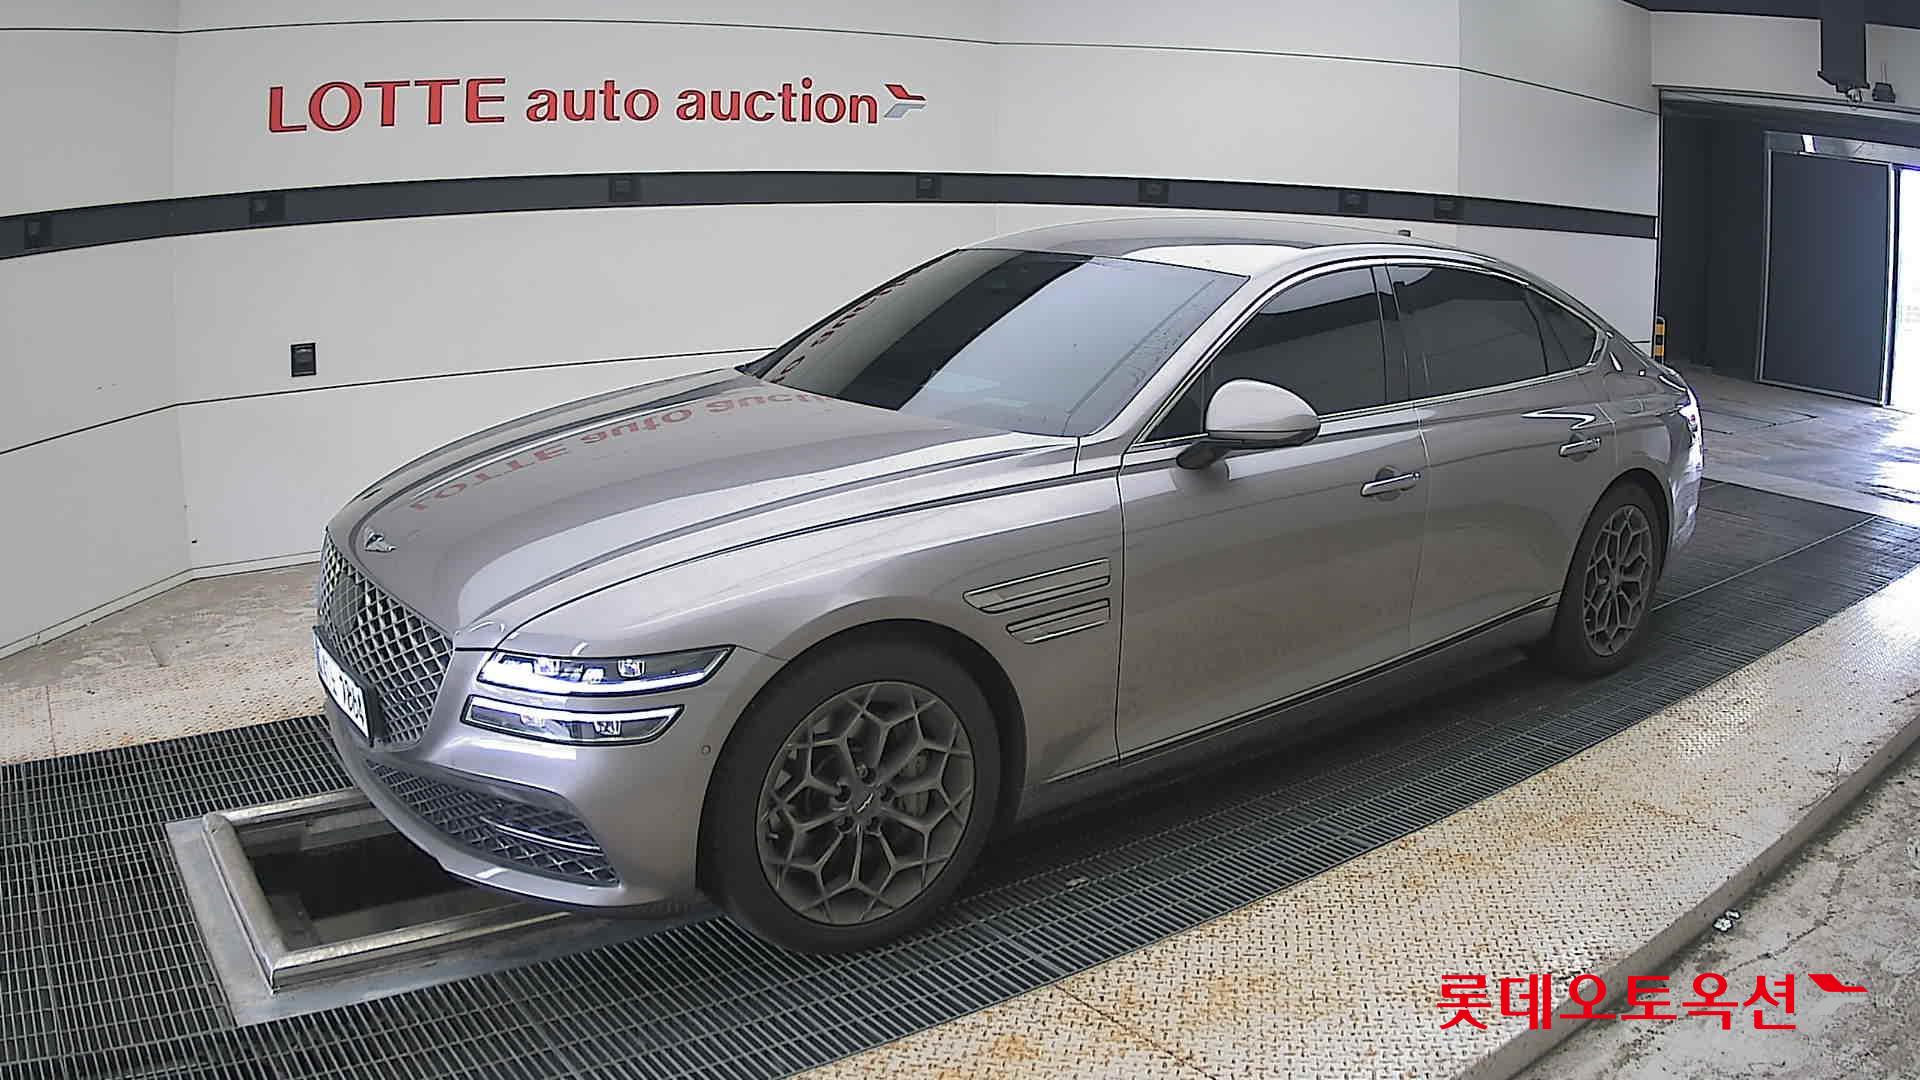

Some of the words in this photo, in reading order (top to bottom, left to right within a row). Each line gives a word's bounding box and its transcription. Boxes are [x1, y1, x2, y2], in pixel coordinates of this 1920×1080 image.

[268, 78, 506, 133] LOTTE
[526, 79, 660, 122] auto
[675, 78, 879, 124] auction
